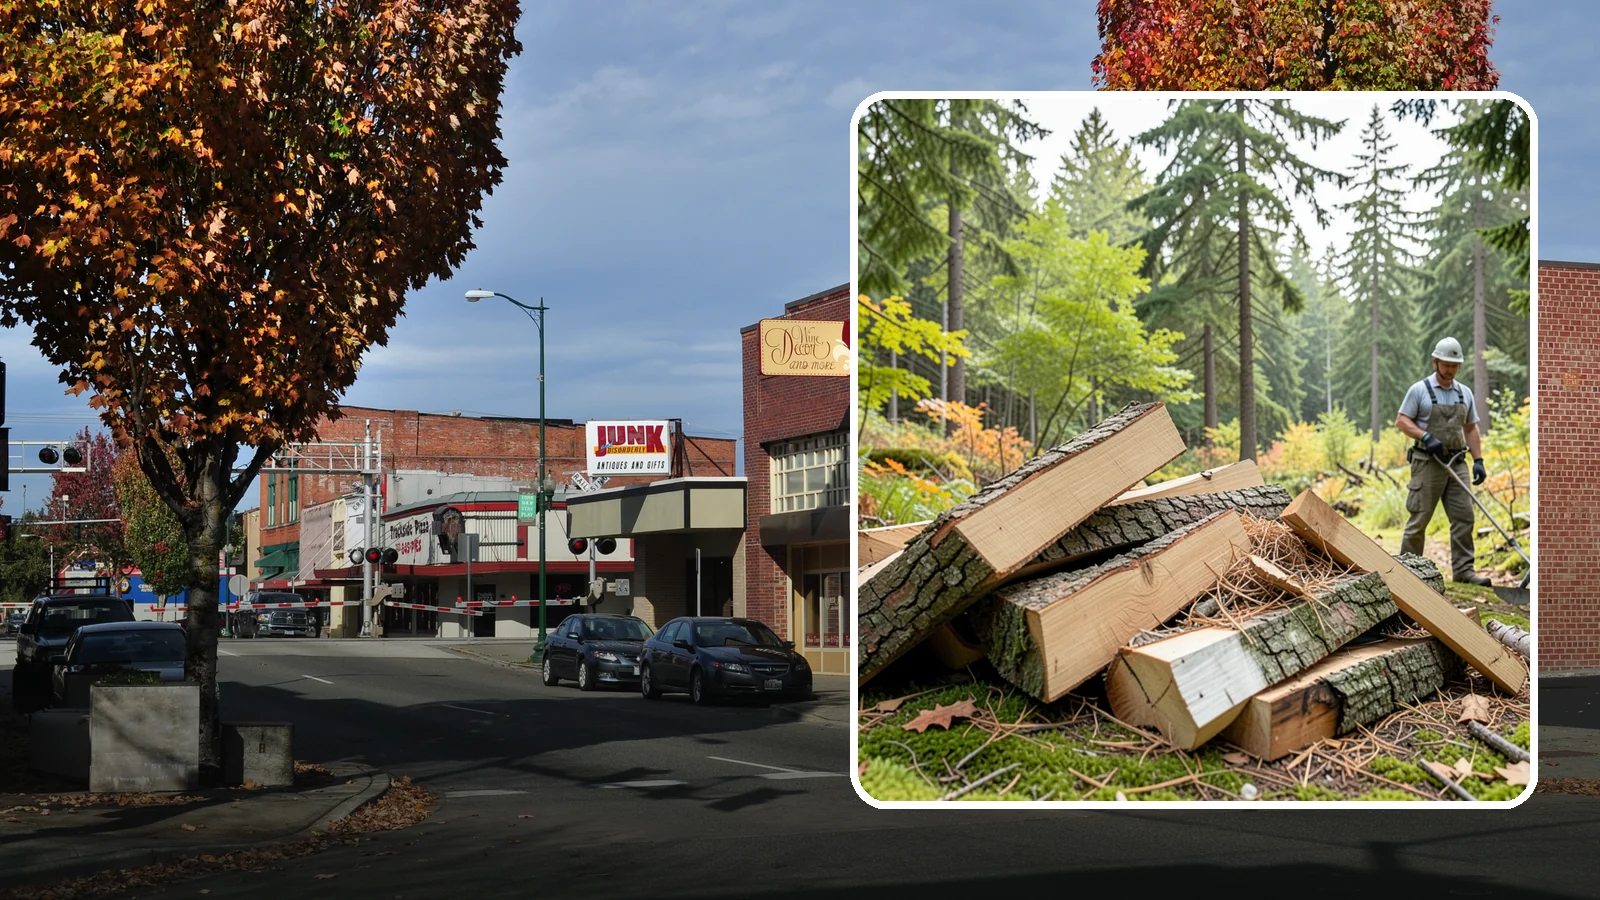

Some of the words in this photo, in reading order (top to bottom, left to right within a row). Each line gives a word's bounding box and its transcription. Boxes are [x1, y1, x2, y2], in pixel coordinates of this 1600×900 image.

[596, 425, 664, 457] JUNK
[607, 446, 646, 454] DISORDERLY
[597, 461, 628, 470] ANTIQUES
[631, 461, 643, 470] AND
[647, 460, 665, 469] GIFTS
[414, 519, 429, 535] Pizza
